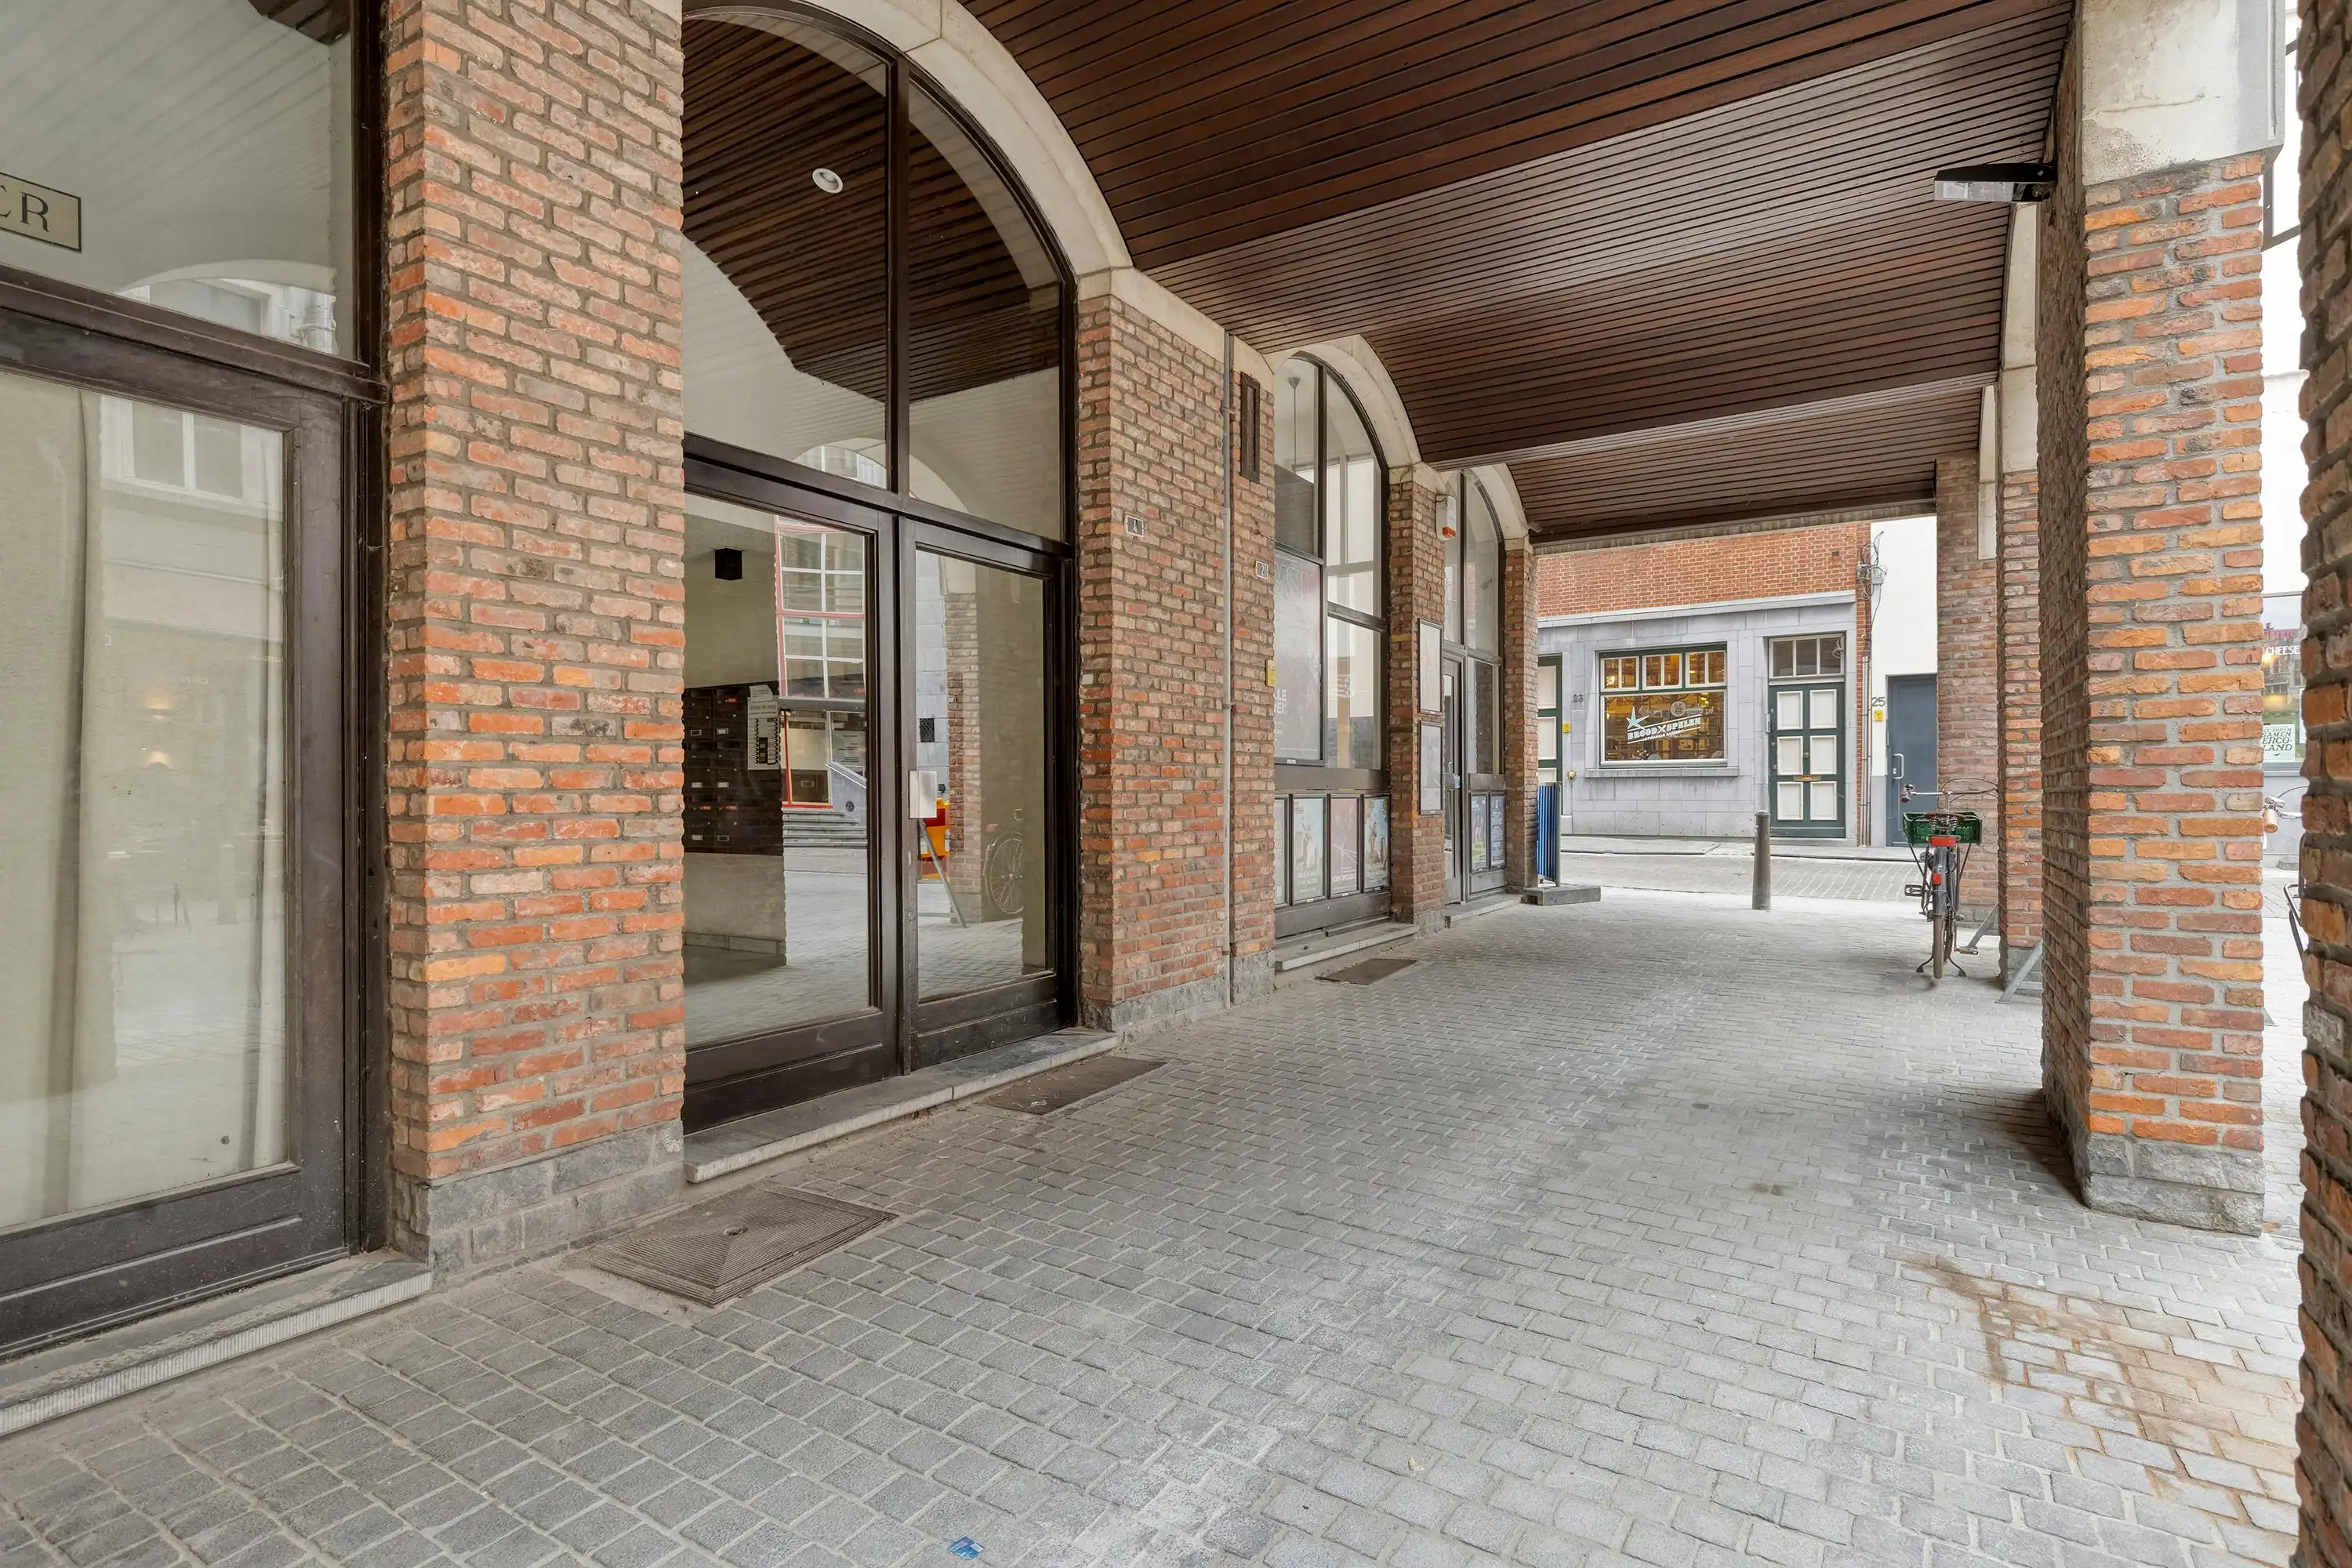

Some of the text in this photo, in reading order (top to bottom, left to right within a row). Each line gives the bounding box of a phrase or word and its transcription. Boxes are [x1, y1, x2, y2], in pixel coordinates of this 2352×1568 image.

[1133, 520, 1138, 534] 4
[1261, 564, 1265, 576] 2
[2266, 645, 2300, 655] CHEESE
[1871, 696, 1886, 706] 25
